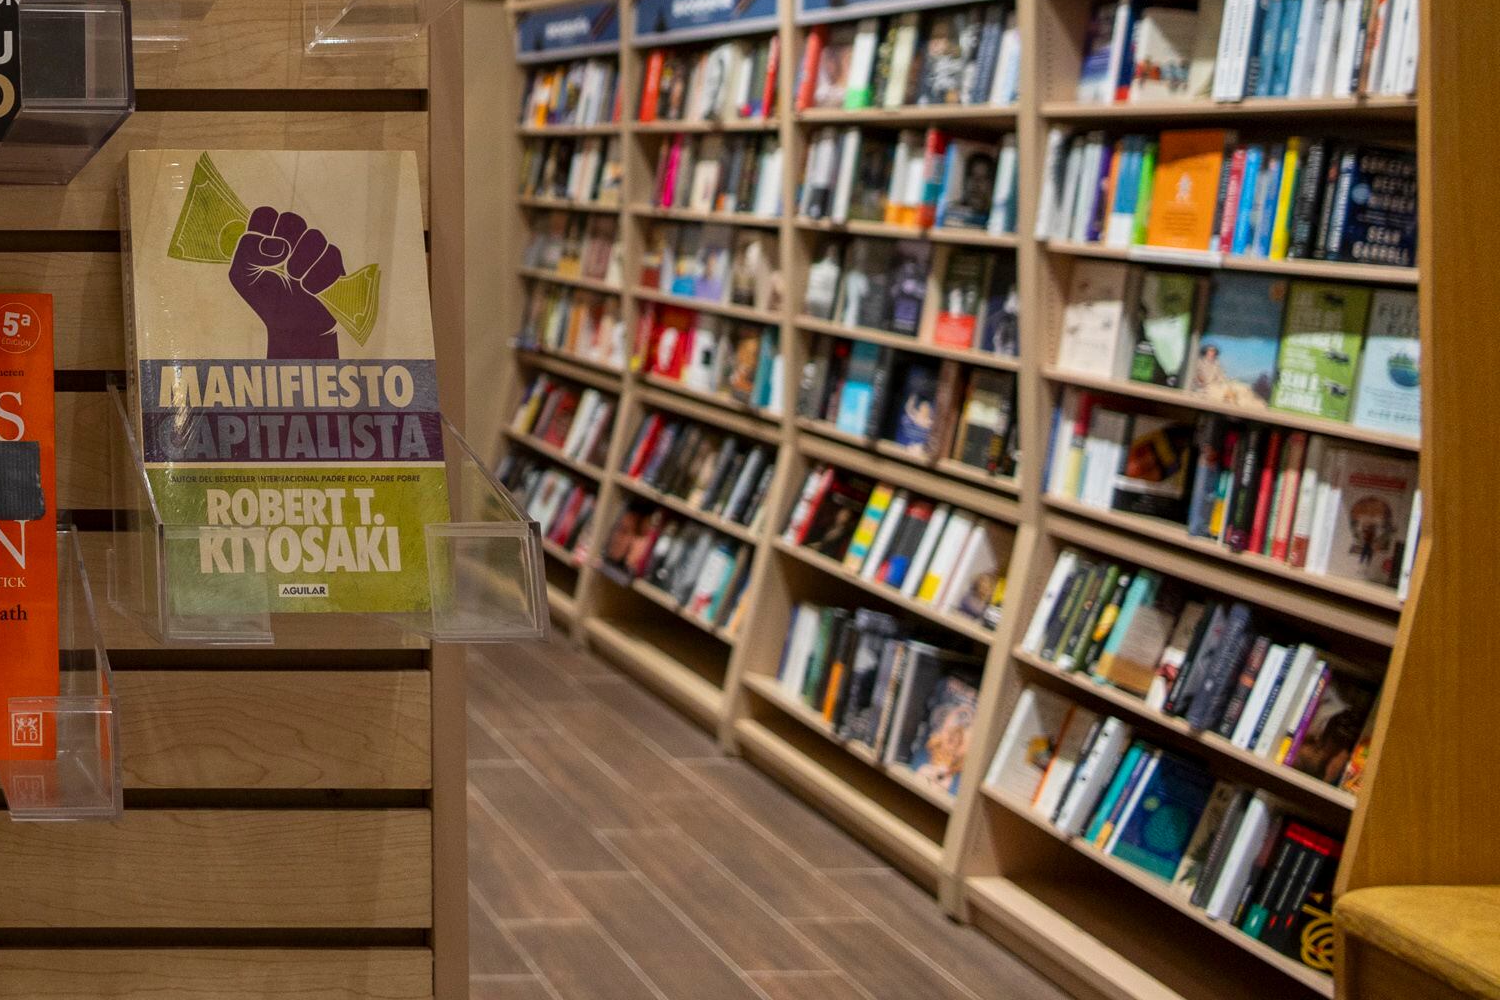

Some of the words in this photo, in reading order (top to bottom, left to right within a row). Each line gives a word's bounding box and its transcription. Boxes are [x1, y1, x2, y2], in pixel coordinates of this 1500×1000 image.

[158, 365, 415, 408] MANIFIESTO
[170, 475, 198, 483] AUTOR
[199, 475, 213, 483] DEL
[215, 475, 256, 483] BESTSELLER
[258, 474, 319, 483] INTERNACIONAL
[321, 474, 346, 482] PADRE
[348, 474, 369, 484] RICO,
[371, 474, 395, 482] PADRE
[397, 474, 421, 482] POBRE
[206, 488, 347, 525] ROBERT
[353, 488, 385, 525] T.
[199, 526, 401, 574] KIYOSAKI
[282, 586, 326, 596] AGUILAR
